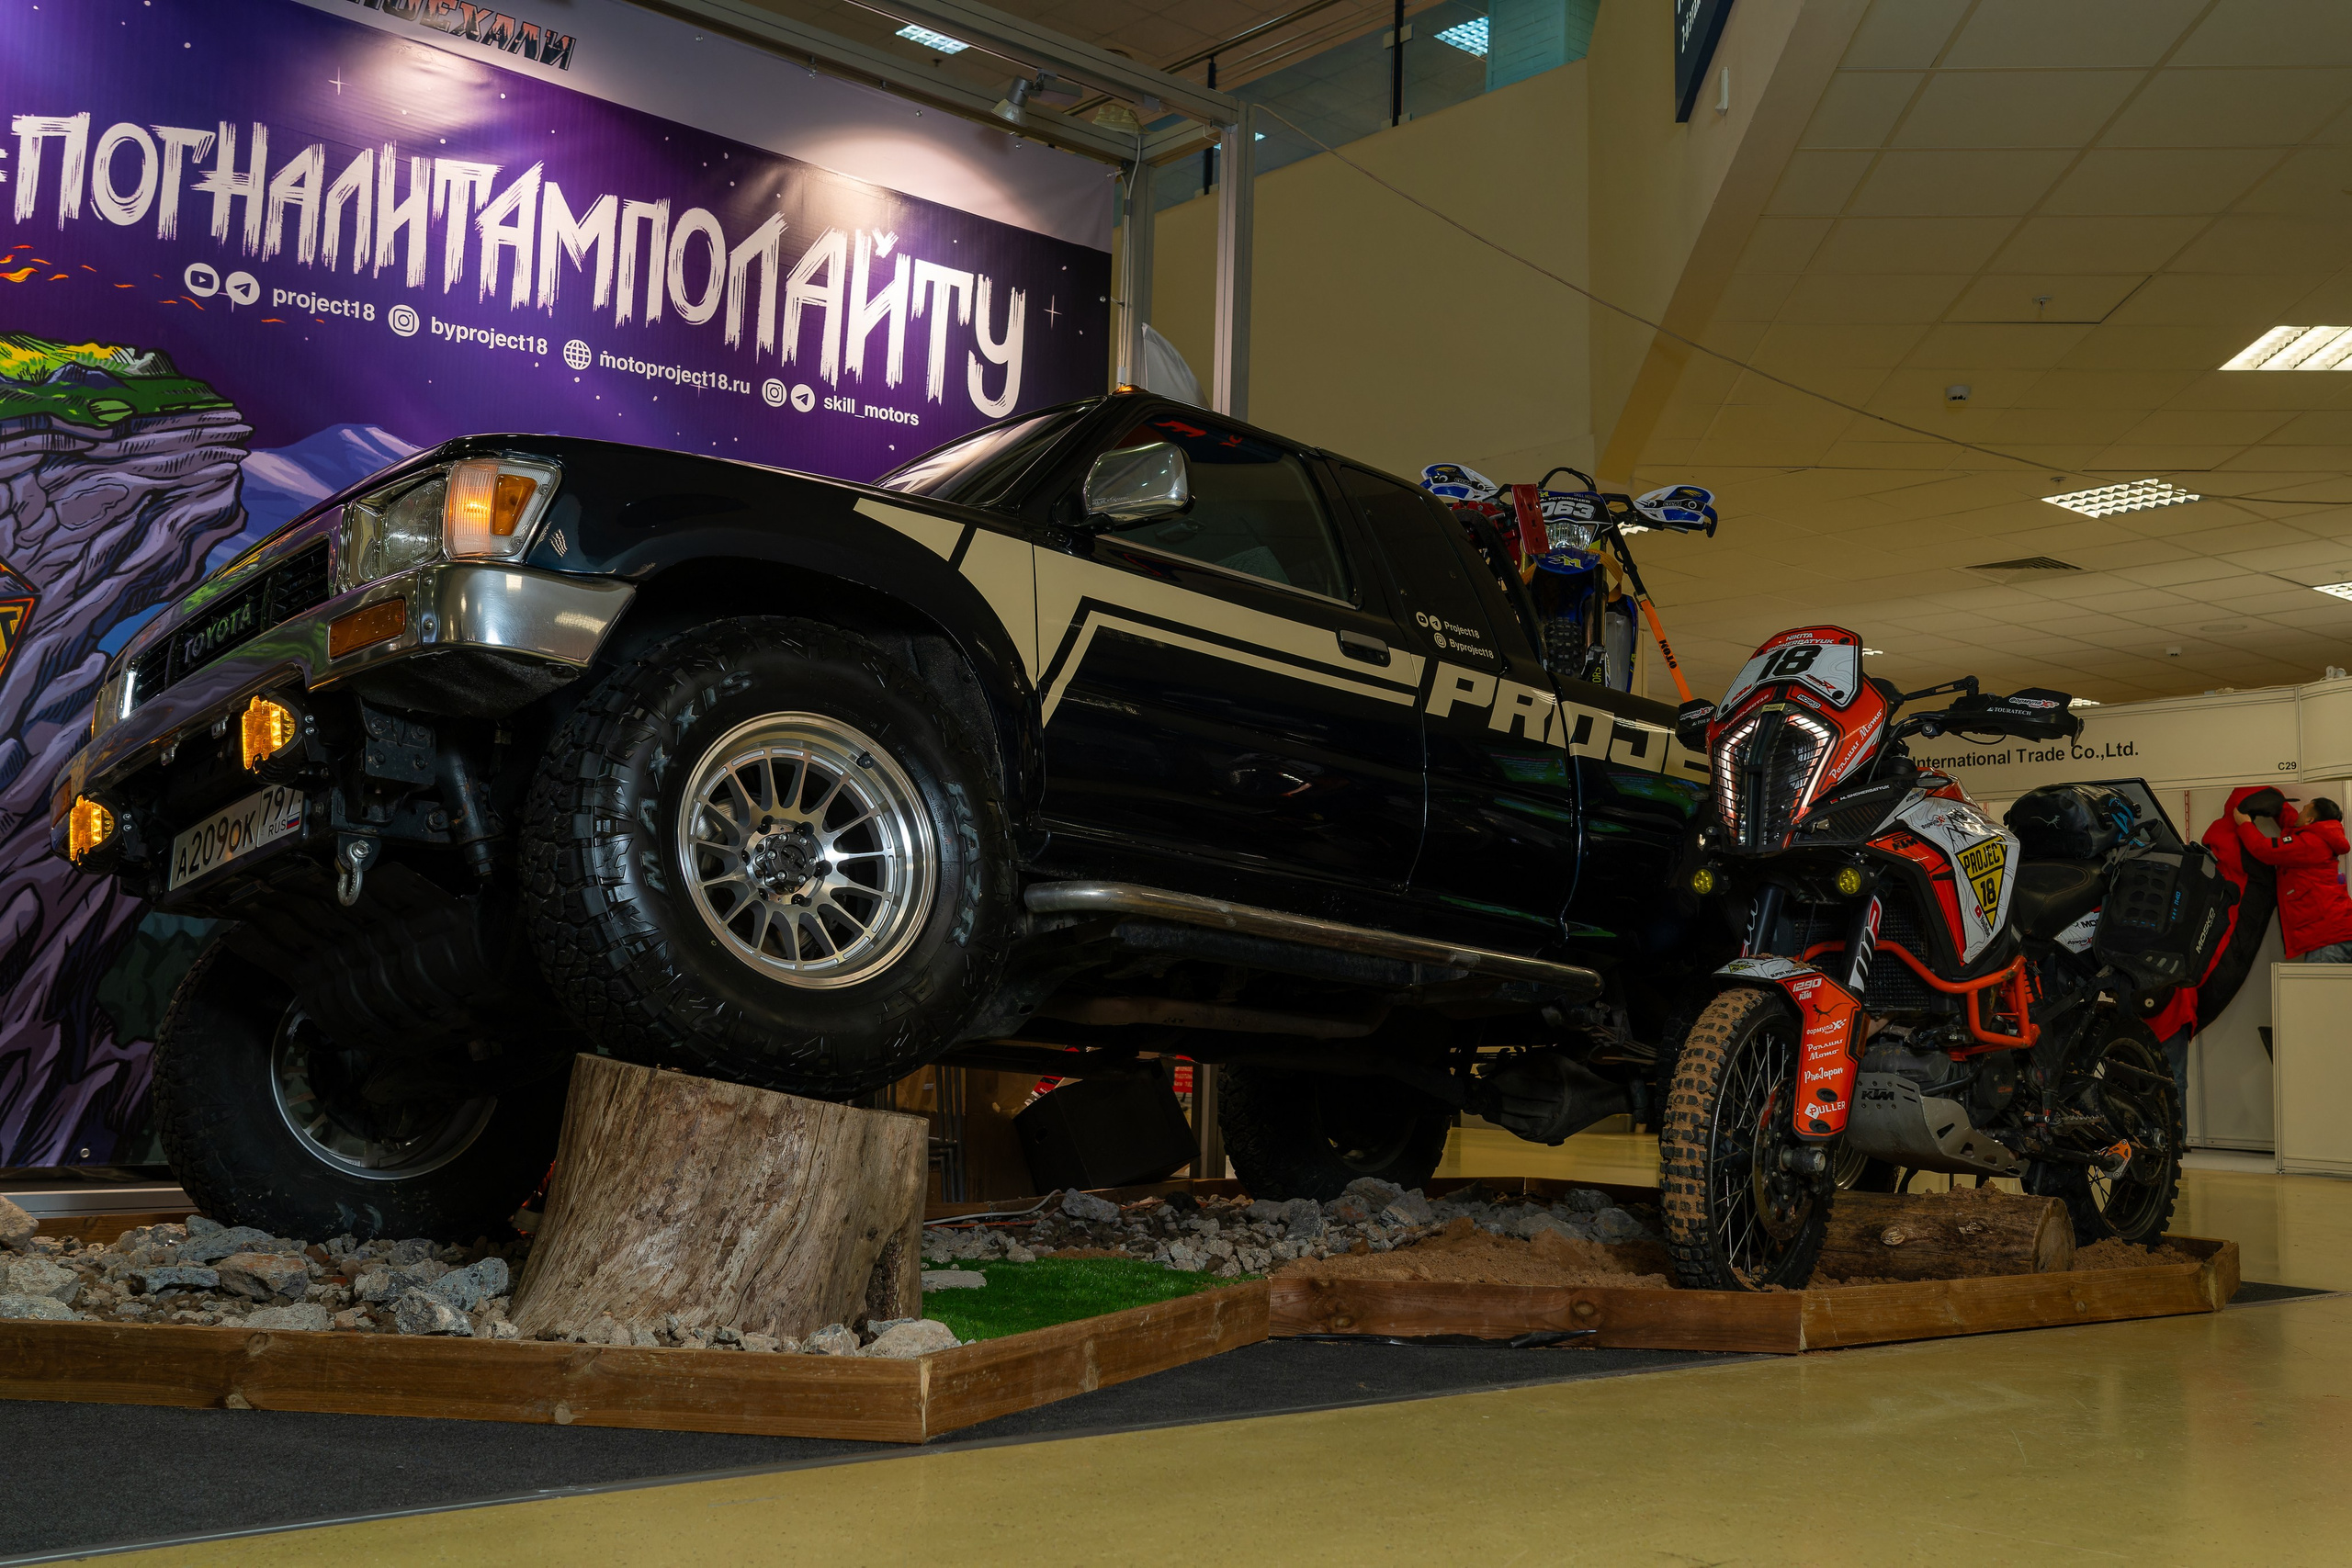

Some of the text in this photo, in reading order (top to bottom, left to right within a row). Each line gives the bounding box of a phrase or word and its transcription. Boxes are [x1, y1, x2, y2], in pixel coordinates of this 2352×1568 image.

[346, 0, 576, 71] ОЕХАЛИ
[0, 111, 1025, 418] ПОГНАЛИТАМПОЛАЙТУ
[273, 288, 376, 321] project18
[431, 316, 548, 355] byproject18
[599, 351, 751, 395] motoproject18.ru
[823, 395, 920, 426] skill_motors
[185, 603, 252, 663] TOYOTA
[1443, 621, 1480, 639] Project18
[1785, 632, 1813, 641] NIKITA
[1449, 638, 1494, 660] Byproject18
[1766, 638, 1835, 653] SHCHERBATYUK
[1758, 644, 1824, 683] 18
[1995, 706, 2032, 716] TOURATECH
[1913, 741, 2139, 770] International Trade Co.,Ltd.
[2278, 761, 2297, 771] C29
[267, 818, 287, 838] RUS
[1891, 836, 1918, 852] KTM
[1980, 877, 1996, 908] 18
[2082, 919, 2098, 929] MO
[2195, 907, 2215, 954] MOSKO
[1792, 977, 1822, 992] 1290
[1798, 990, 1812, 1001] KTM
[1804, 1066, 1844, 1084] ProJapan
[1861, 1088, 1894, 1100] KTM
[1809, 1100, 1846, 1115] PULLER
